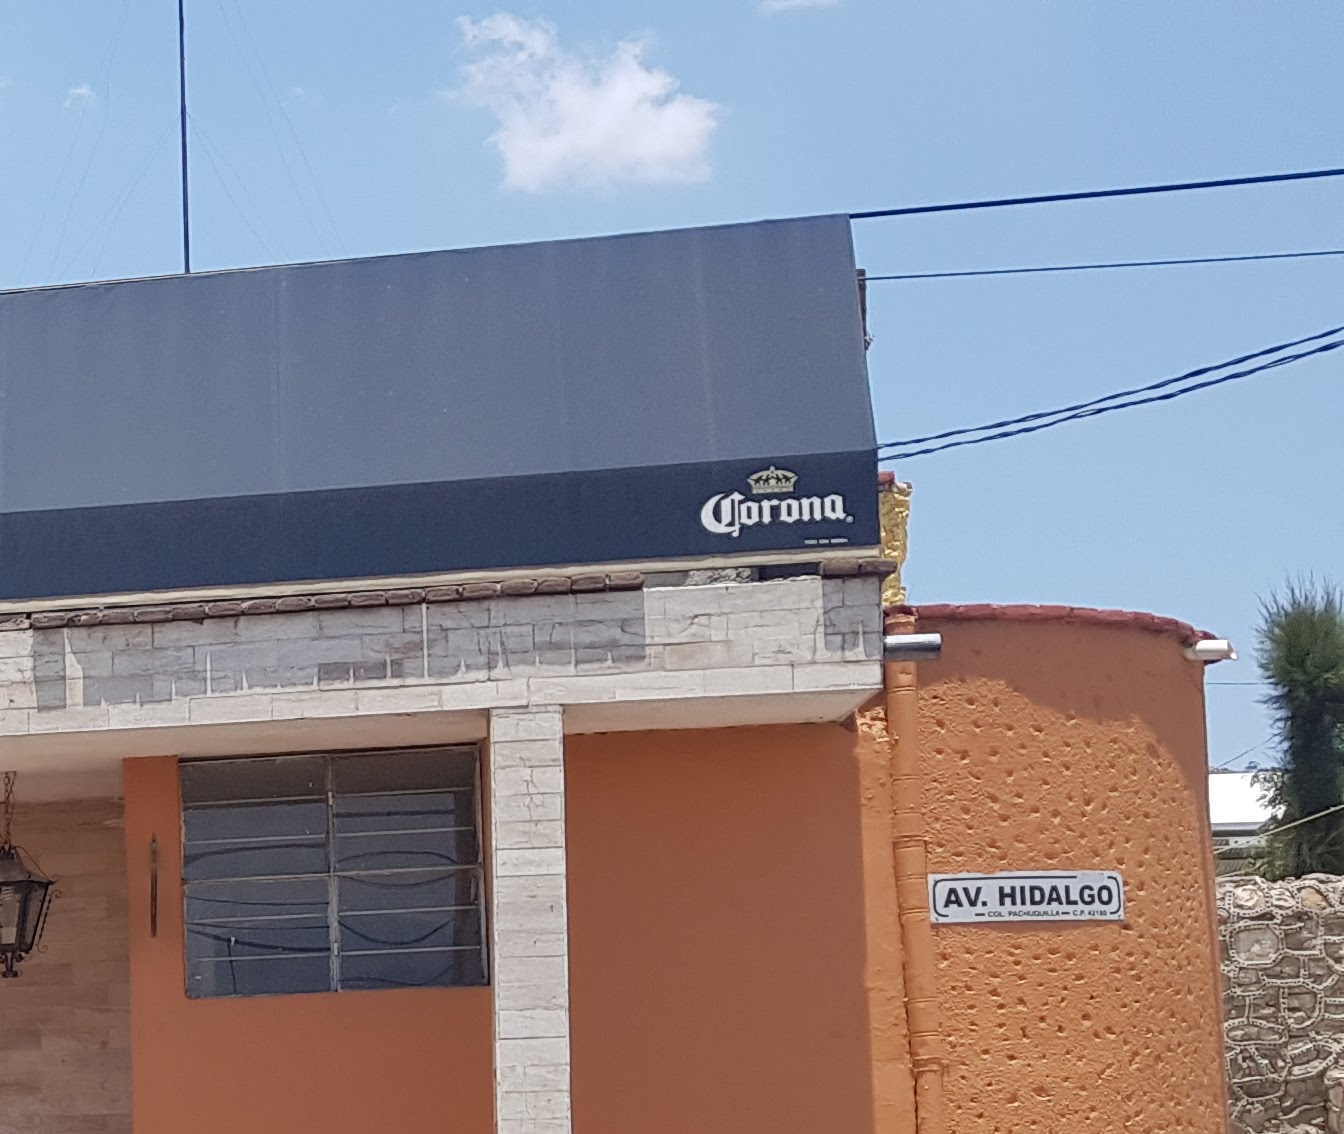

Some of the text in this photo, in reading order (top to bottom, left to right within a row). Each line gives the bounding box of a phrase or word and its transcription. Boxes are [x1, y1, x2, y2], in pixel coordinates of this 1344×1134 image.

[700, 490, 848, 538] Corona
[943, 884, 1114, 909] AV. HIDALGO
